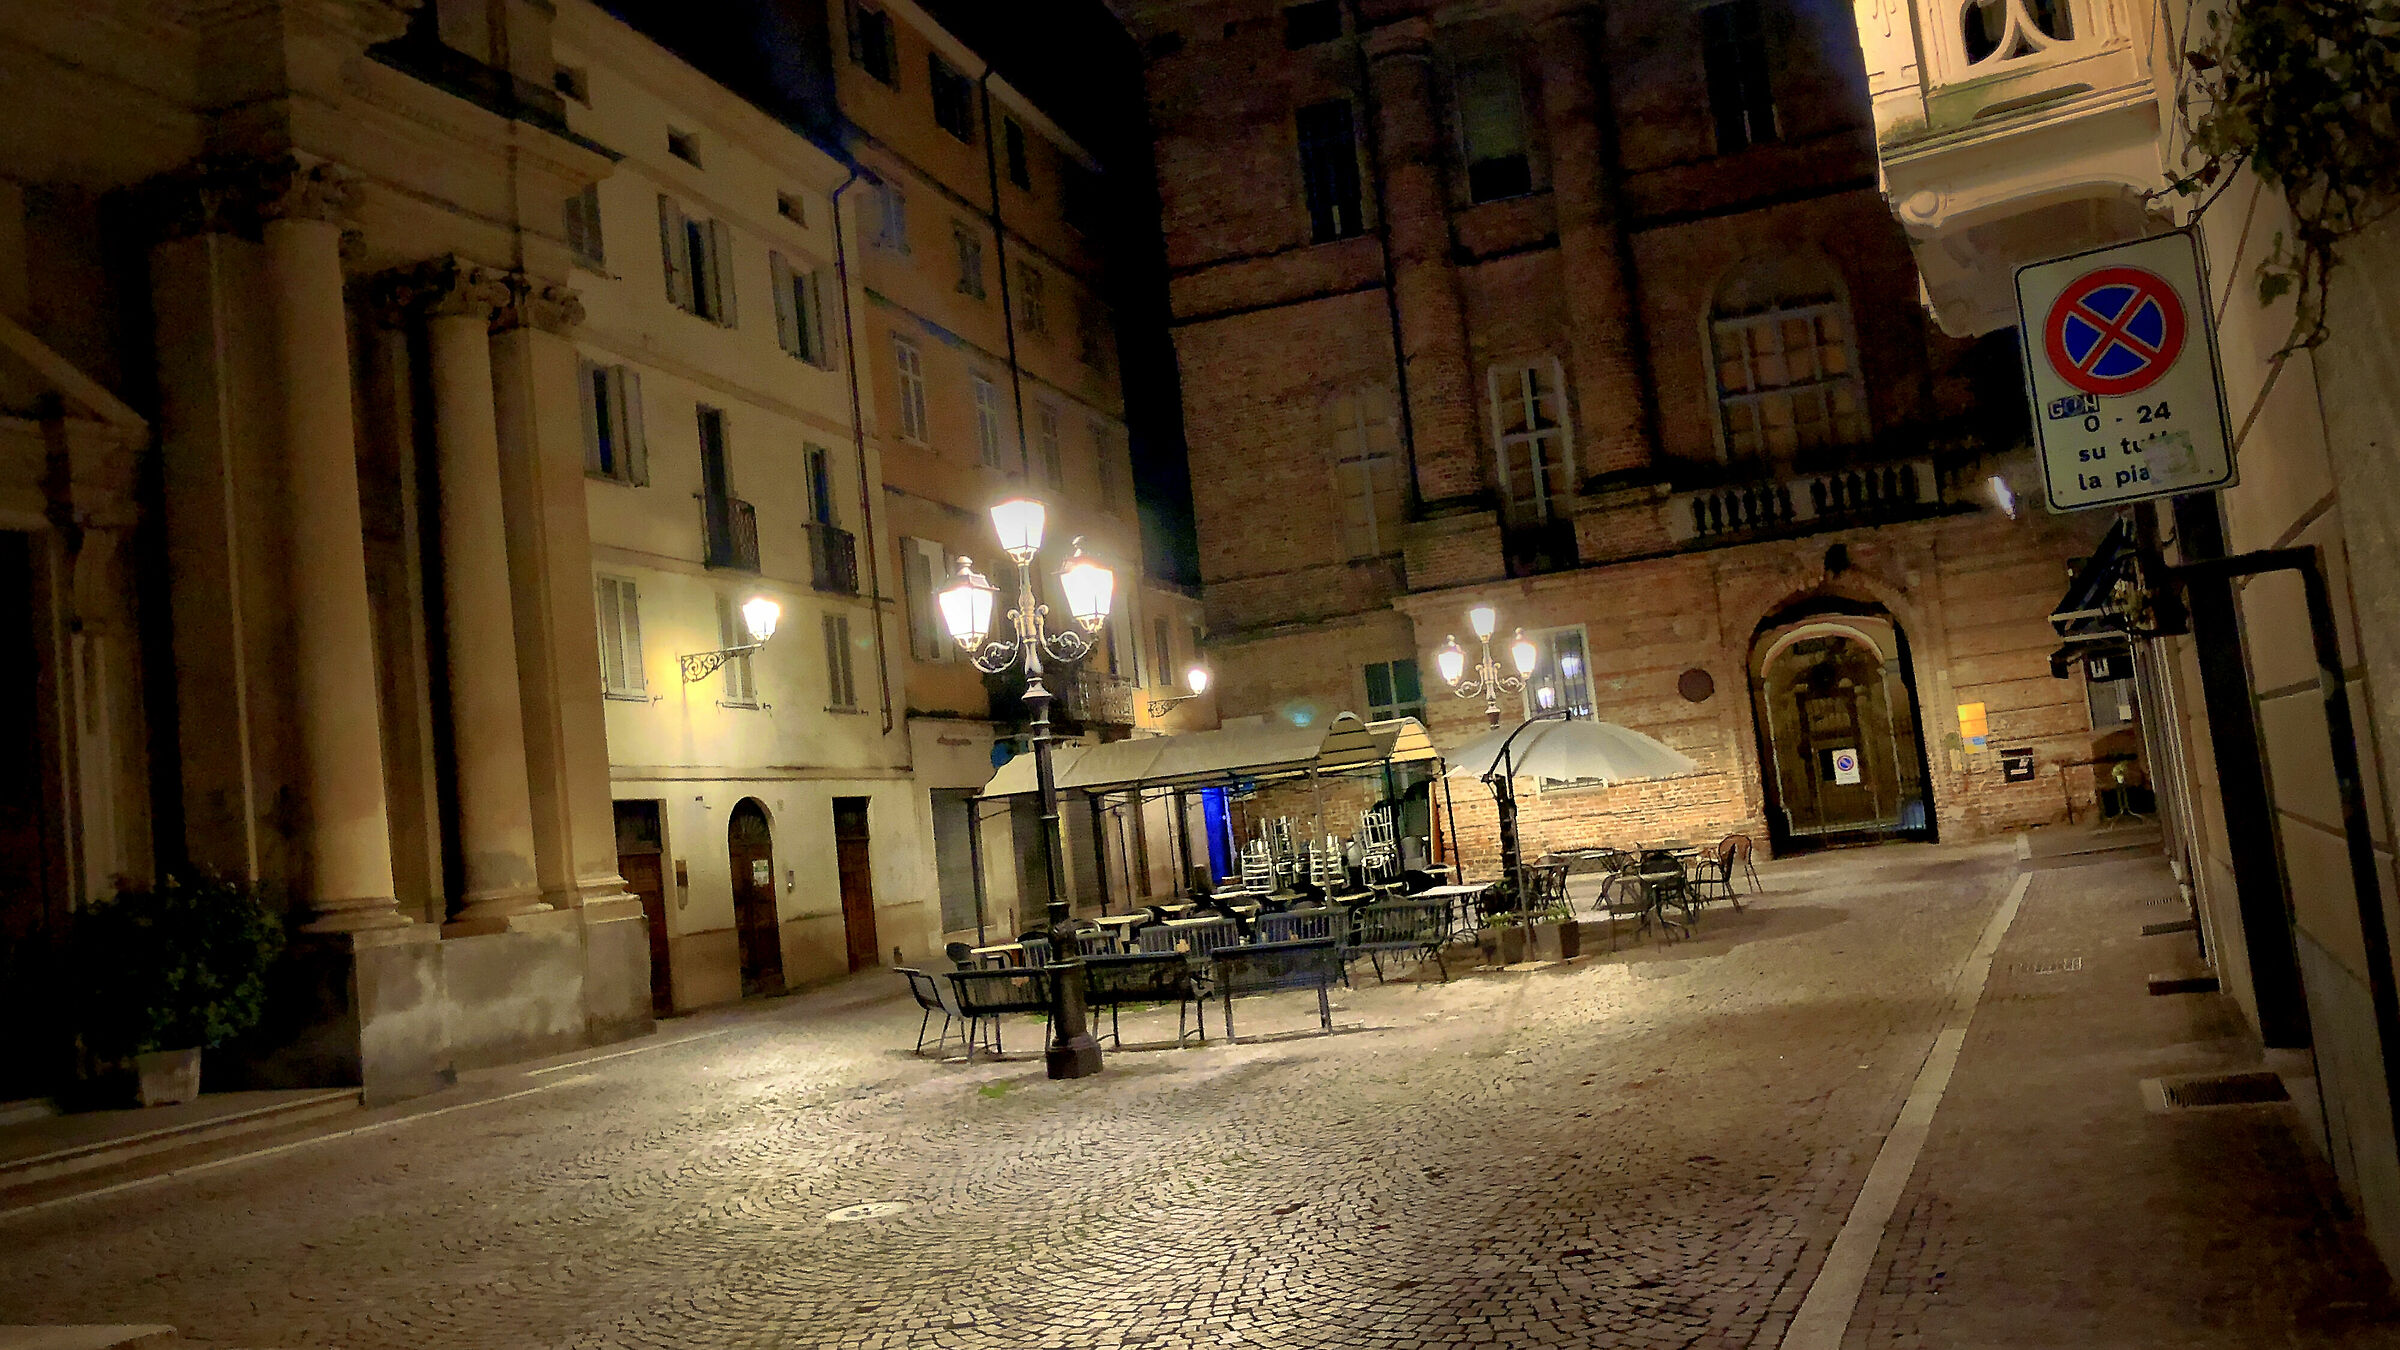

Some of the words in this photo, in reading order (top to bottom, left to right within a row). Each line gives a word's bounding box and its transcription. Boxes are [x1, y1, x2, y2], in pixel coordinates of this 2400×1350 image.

[2136, 401, 2171, 424] 24
[2078, 446, 2106, 462] su
[2078, 473, 2102, 491] la
